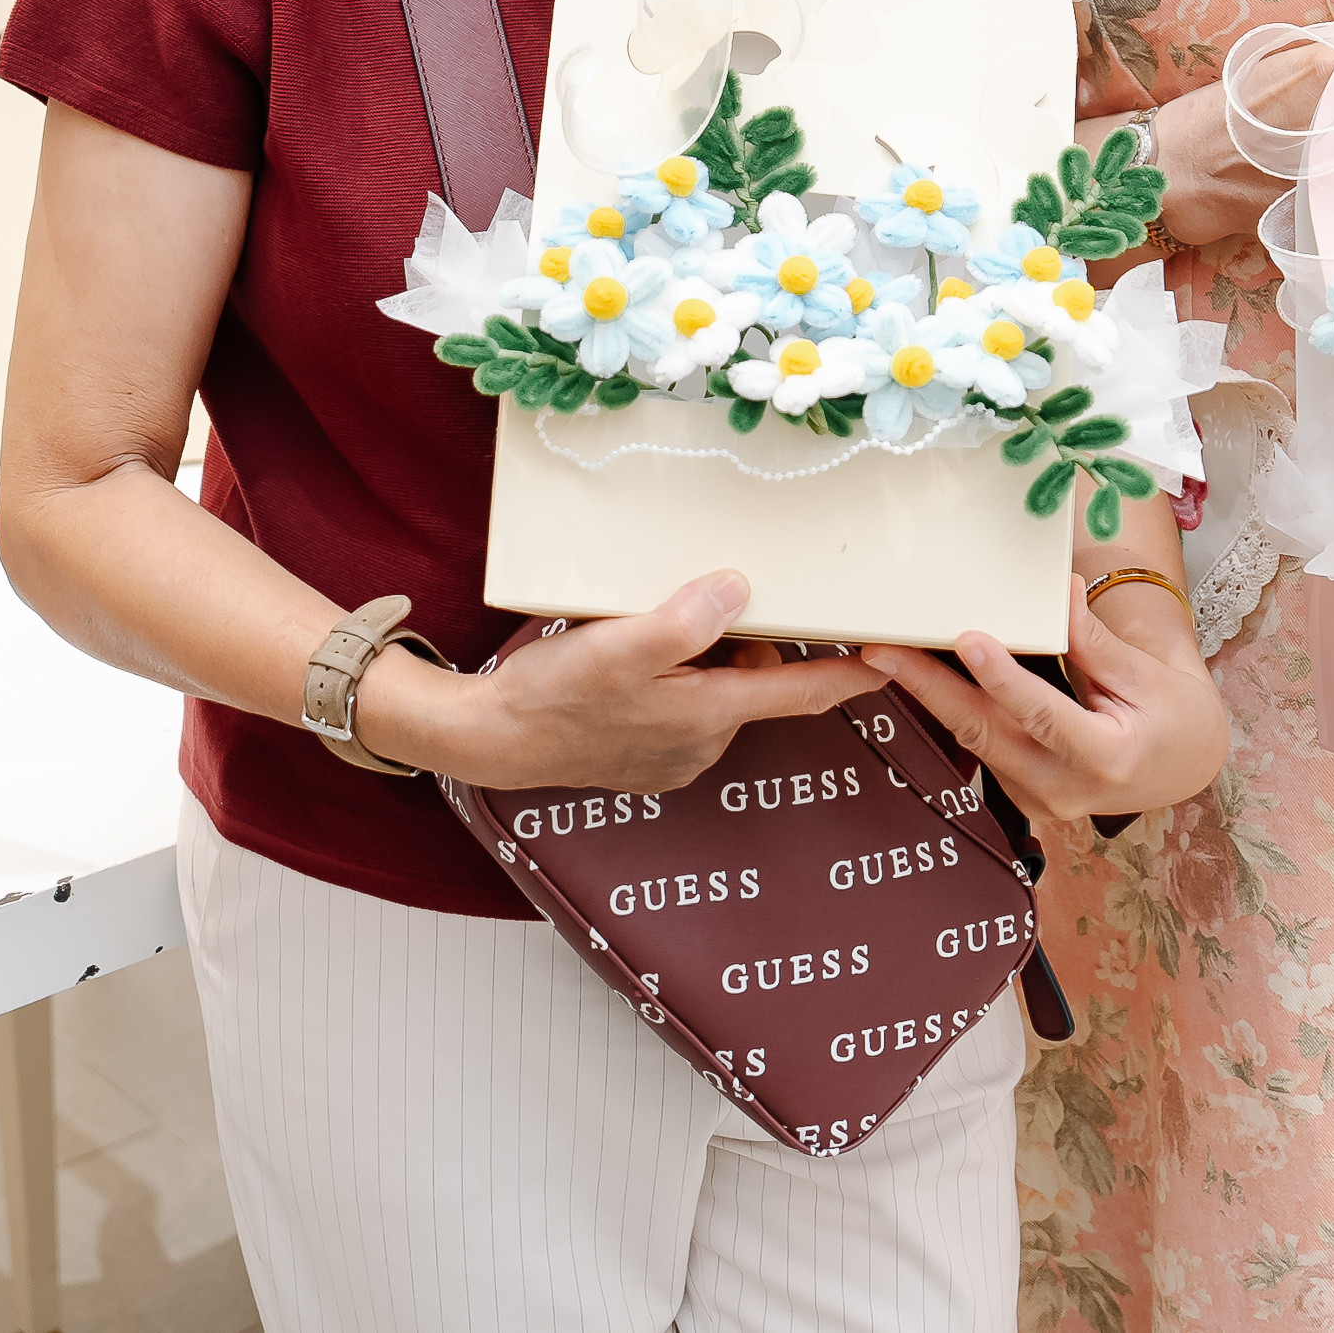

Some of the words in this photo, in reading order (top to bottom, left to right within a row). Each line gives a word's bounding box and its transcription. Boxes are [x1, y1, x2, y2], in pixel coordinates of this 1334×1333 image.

[513, 792, 662, 839] GUESS
[720, 766, 861, 812] GUESS
[609, 868, 761, 916] GUESS
[829, 836, 959, 890] GUESS
[721, 944, 870, 995] GUESS
[830, 1009, 969, 1062] GUESS
